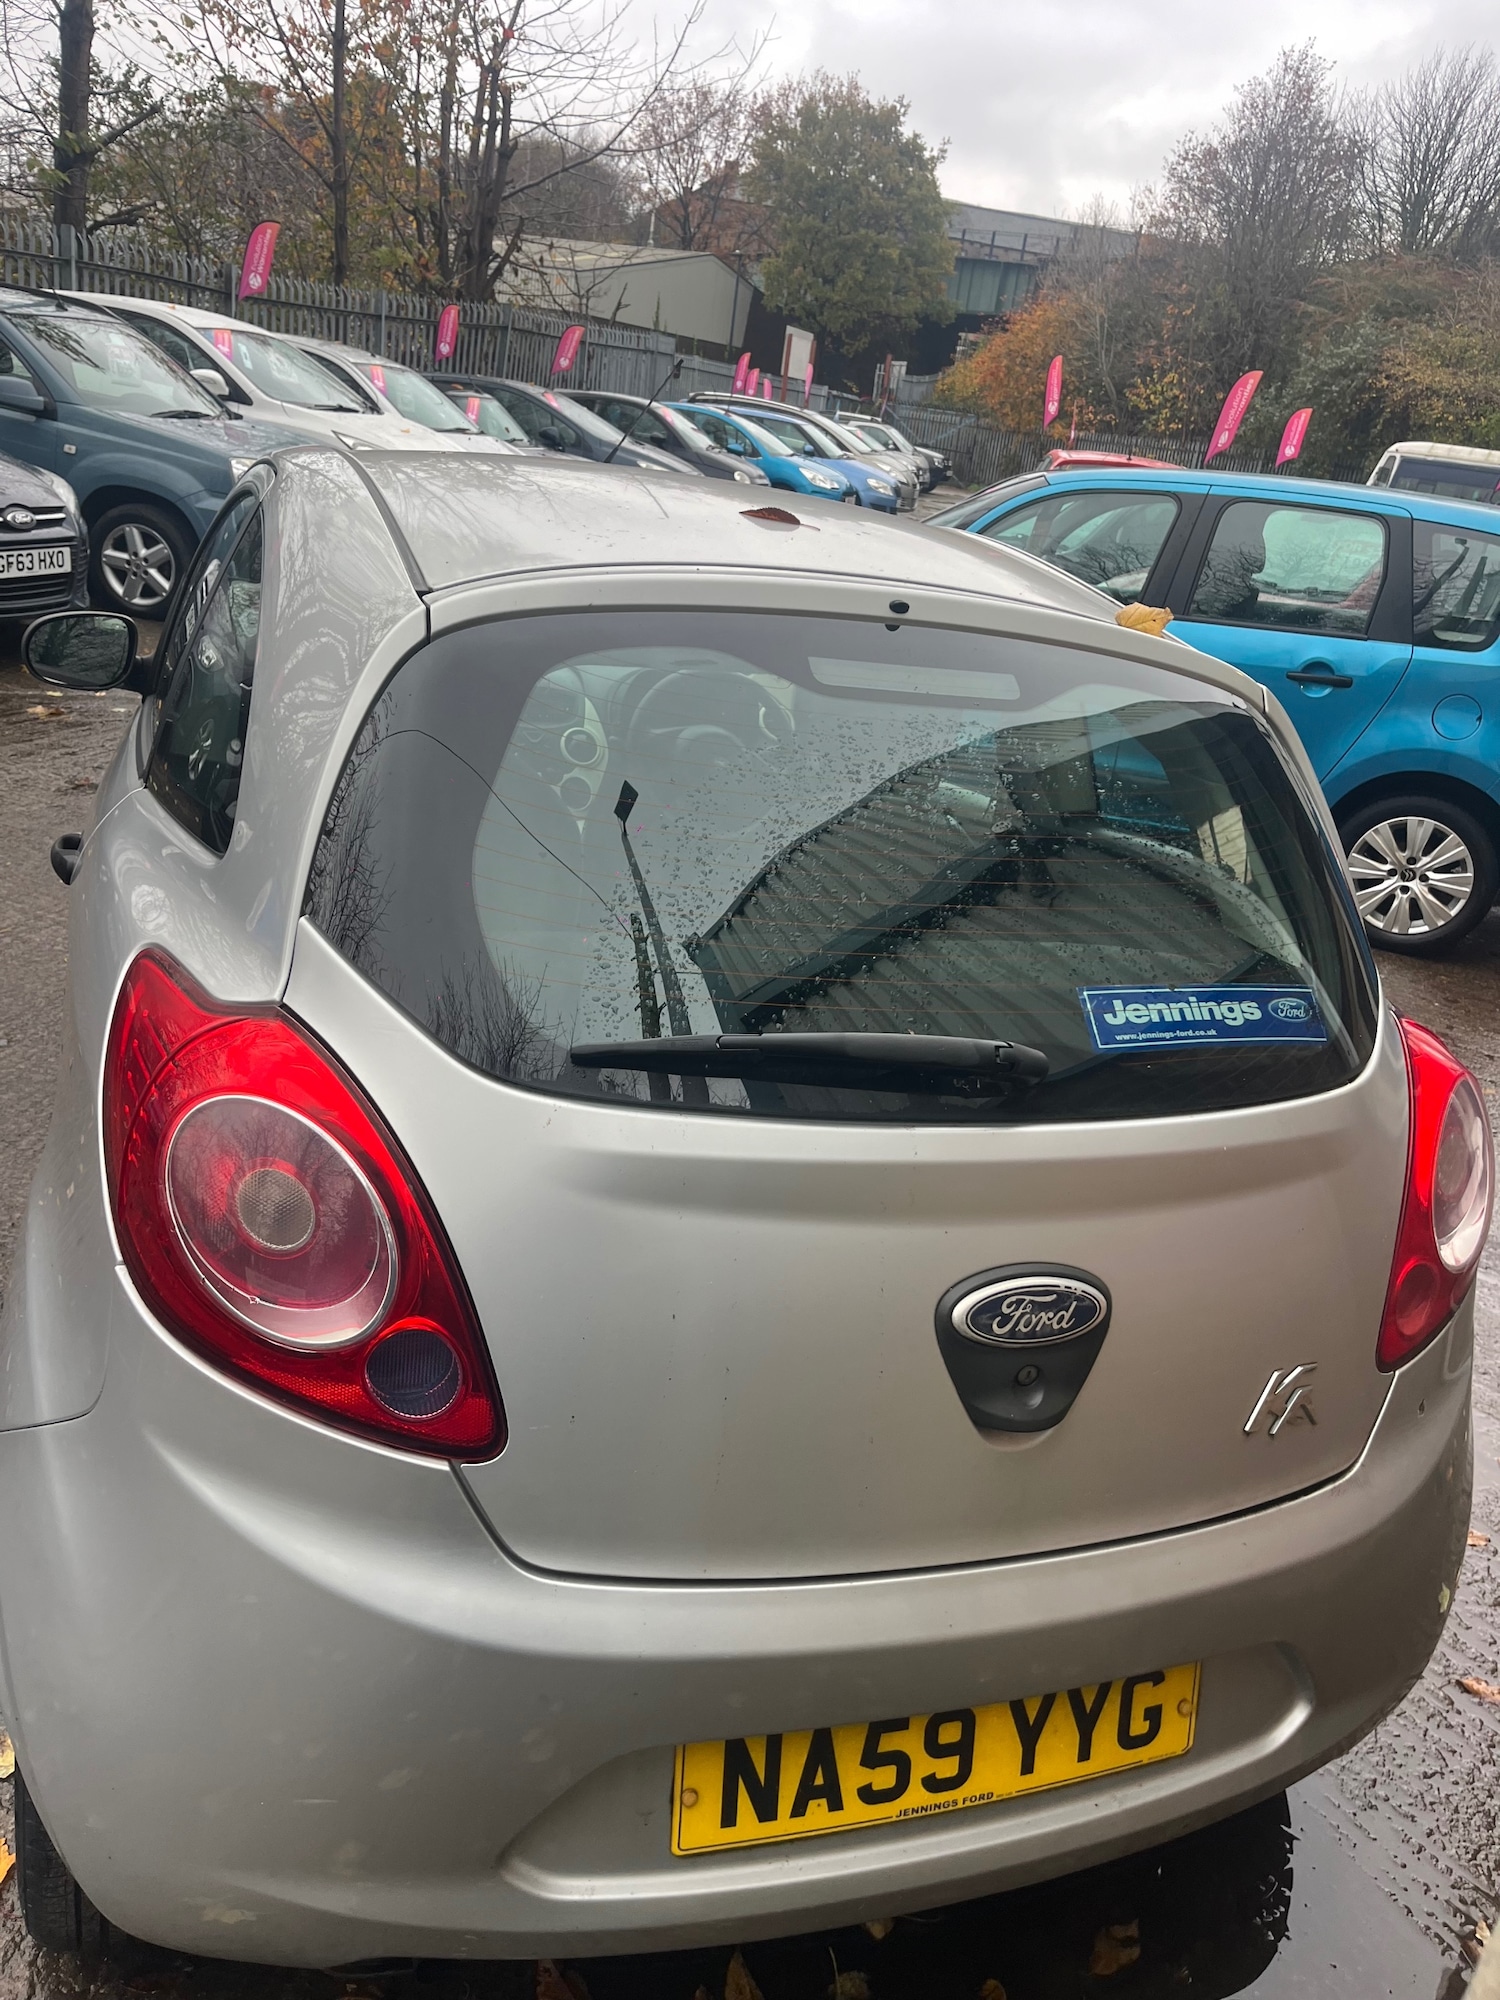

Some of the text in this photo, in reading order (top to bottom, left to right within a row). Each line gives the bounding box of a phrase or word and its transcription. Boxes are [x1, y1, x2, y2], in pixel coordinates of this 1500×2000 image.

[257, 228, 273, 273] Warranties
[1224, 387, 1244, 428] Evolution
[1229, 378, 1255, 428] rranties
[0, 552, 34, 573] GF63
[1103, 996, 1306, 1026] Jennings Ford
[1115, 1028, 1218, 1041] www.jennings-ford.co.uk
[991, 1294, 1078, 1335] Ford
[719, 1670, 1166, 1829] NA59 YYG
[895, 1797, 958, 1818] JENNINGS
[962, 1790, 995, 1806] FORD
